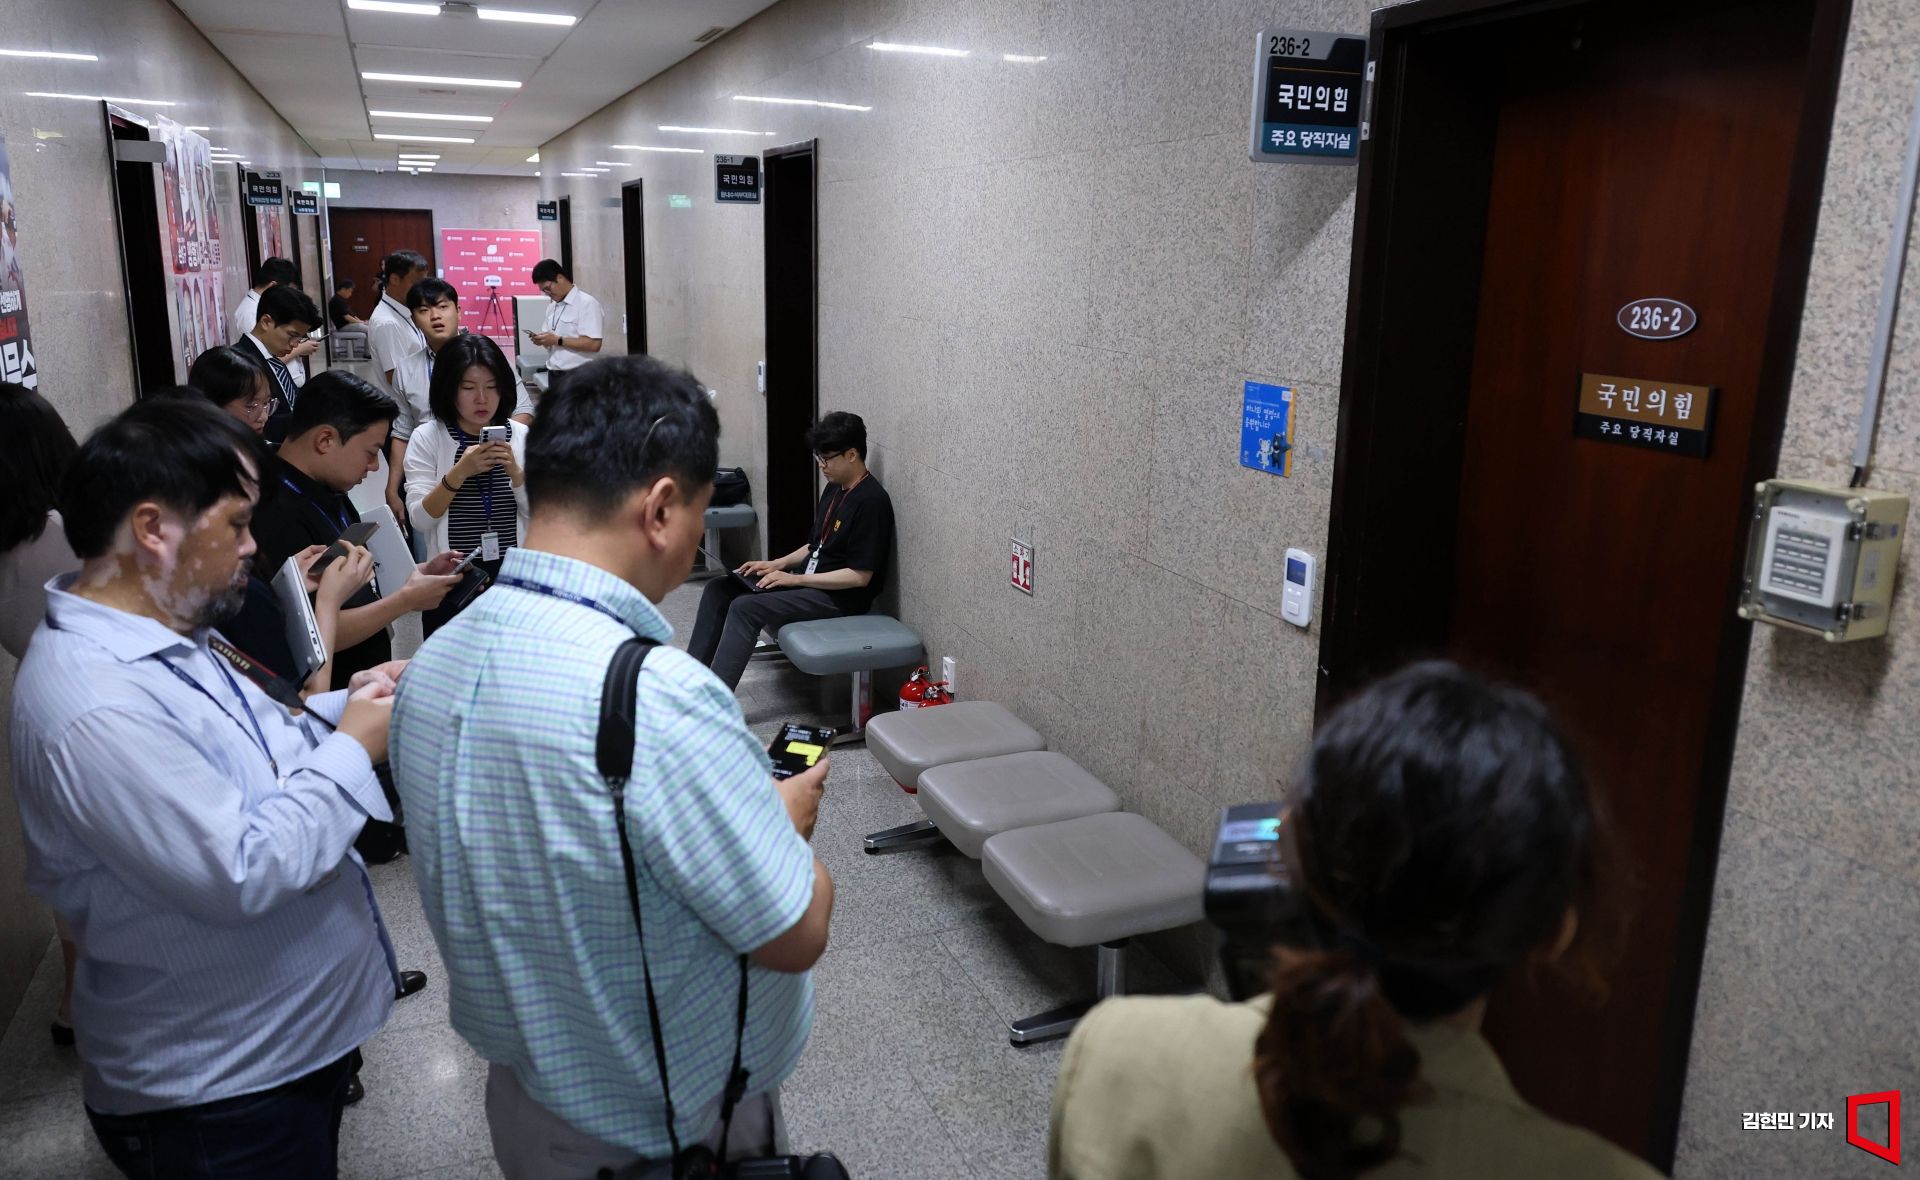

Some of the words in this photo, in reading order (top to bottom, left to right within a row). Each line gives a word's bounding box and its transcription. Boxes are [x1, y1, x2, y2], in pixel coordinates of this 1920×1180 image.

[1270, 36, 1310, 56] 236-2
[1279, 84, 1348, 112] 국민의힘
[1271, 130, 1297, 146] 주요
[1301, 131, 1351, 149] 당직자실
[252, 185, 278, 194] 국민의힘
[723, 174, 754, 185] 국민의힘
[1630, 306, 1682, 331] 236-2
[1598, 383, 1693, 420] 국민의힘
[1600, 421, 1622, 435] 주요
[1630, 425, 1679, 446] 당직자실
